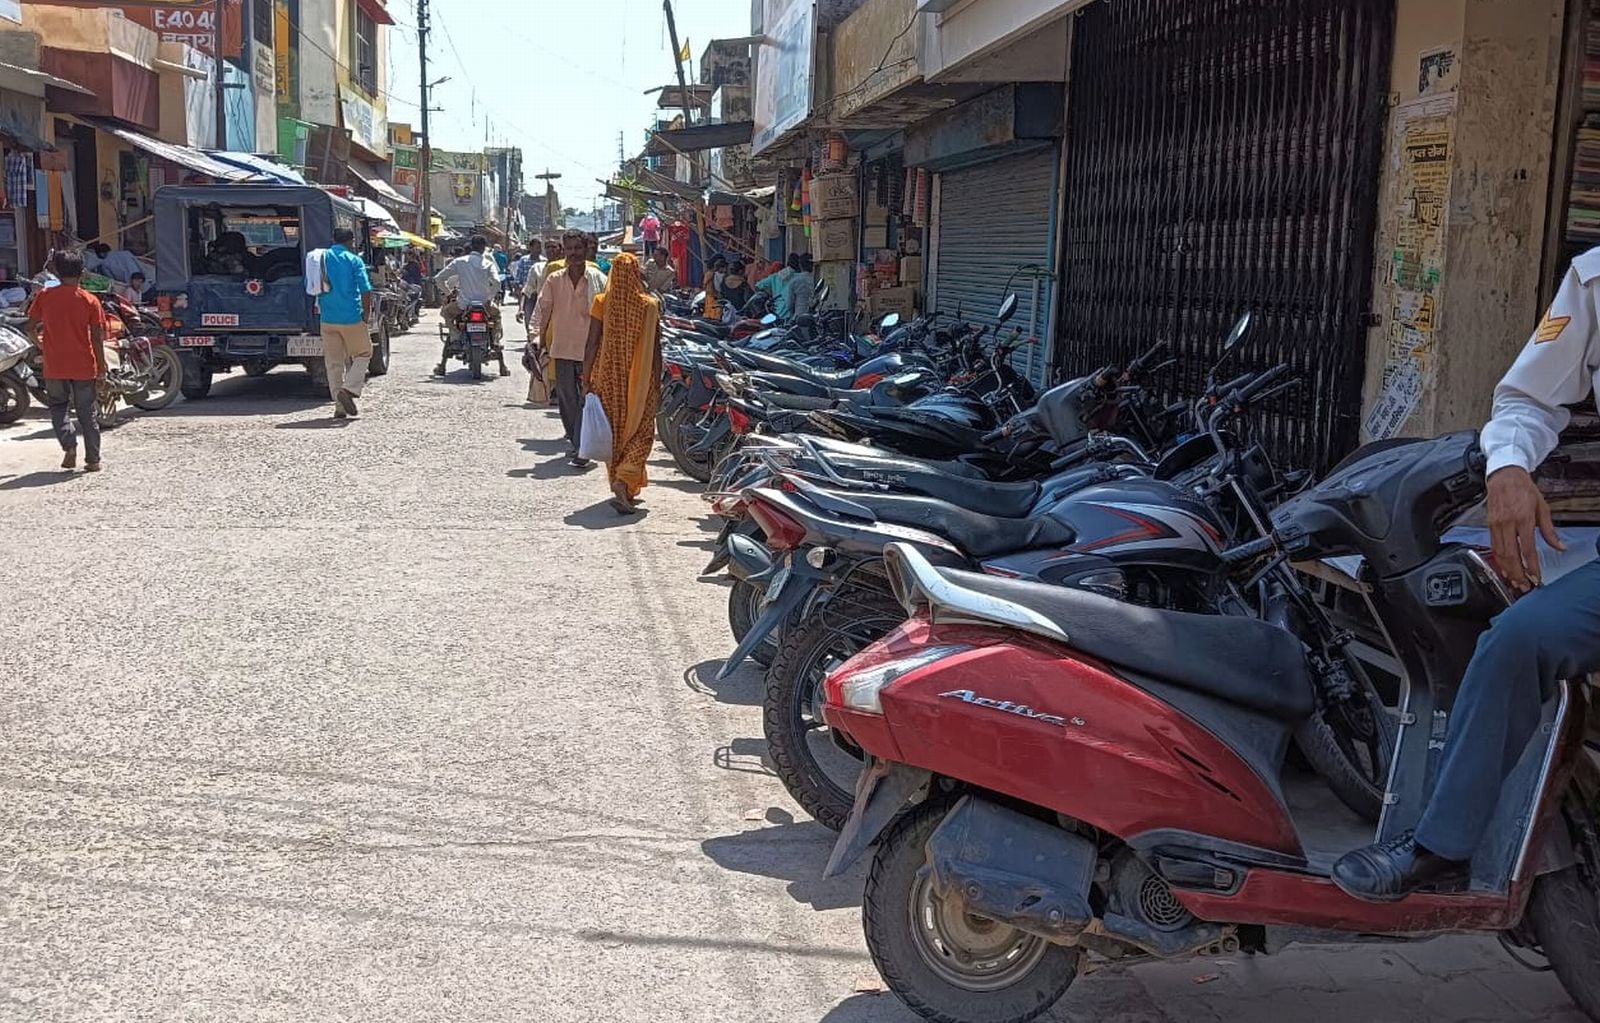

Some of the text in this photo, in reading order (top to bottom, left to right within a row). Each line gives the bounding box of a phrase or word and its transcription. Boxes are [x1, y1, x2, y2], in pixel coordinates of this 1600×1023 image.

[203, 315, 237, 325] POLICE
[183, 336, 211, 345] STOP
[936, 689, 1068, 727] Activa
